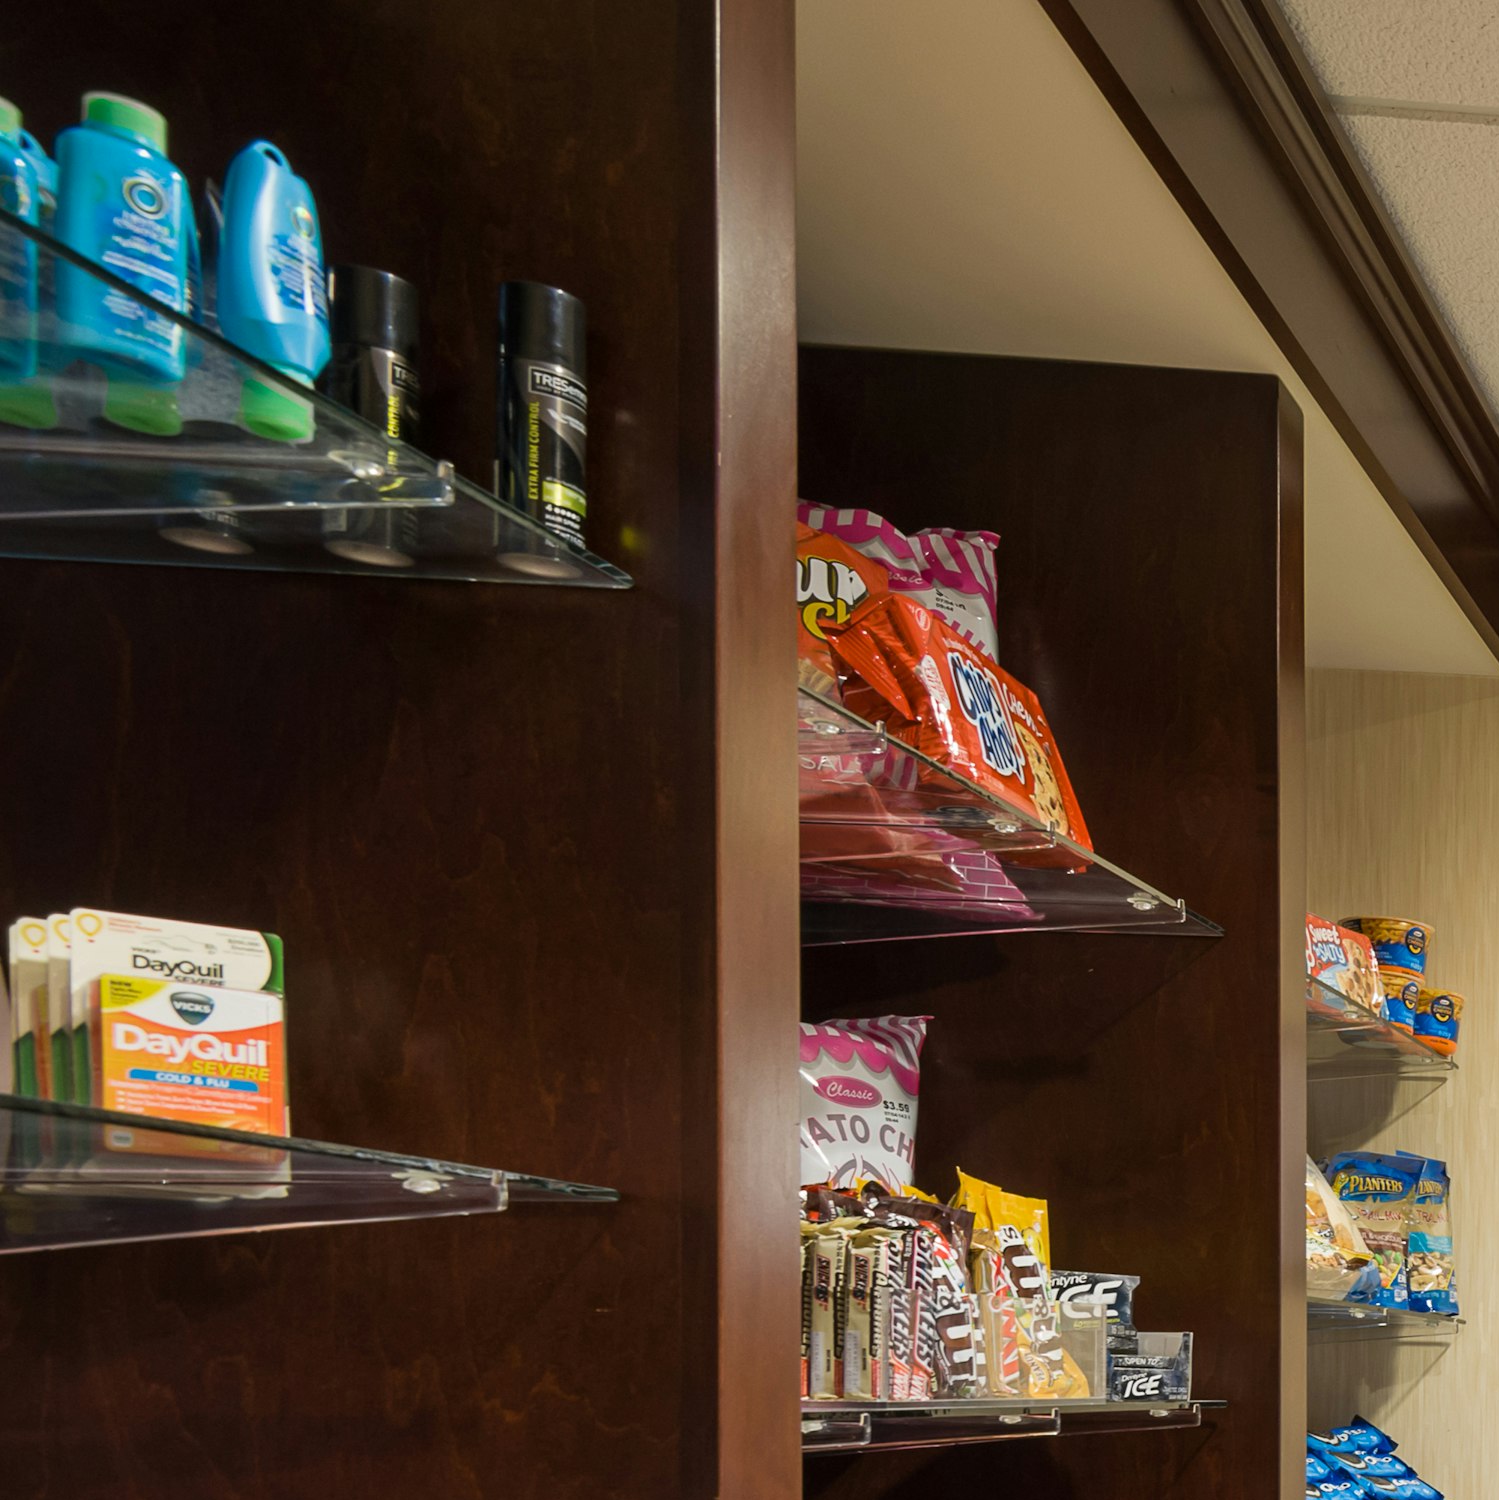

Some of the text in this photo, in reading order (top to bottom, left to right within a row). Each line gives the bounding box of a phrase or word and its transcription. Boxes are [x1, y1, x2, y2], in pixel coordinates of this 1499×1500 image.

[528, 401, 540, 444] CONTROL
[1308, 924, 1341, 945] Sweet
[132, 954, 225, 978] DayQuil
[172, 1000, 212, 1013] VICKS
[112, 1022, 268, 1067] DayQuil
[155, 1072, 230, 1088] COLD & FLU
[191, 1059, 270, 1082] SEVERE
[826, 1081, 874, 1101] Classic
[882, 1100, 911, 1113] $3.59
[800, 1113, 871, 1149] ATO
[1349, 1174, 1403, 1193] PLANTERS
[816, 1257, 831, 1302] SNICKERS
[854, 1255, 869, 1300] SNICKERS
[1123, 1375, 1163, 1399] ICE
